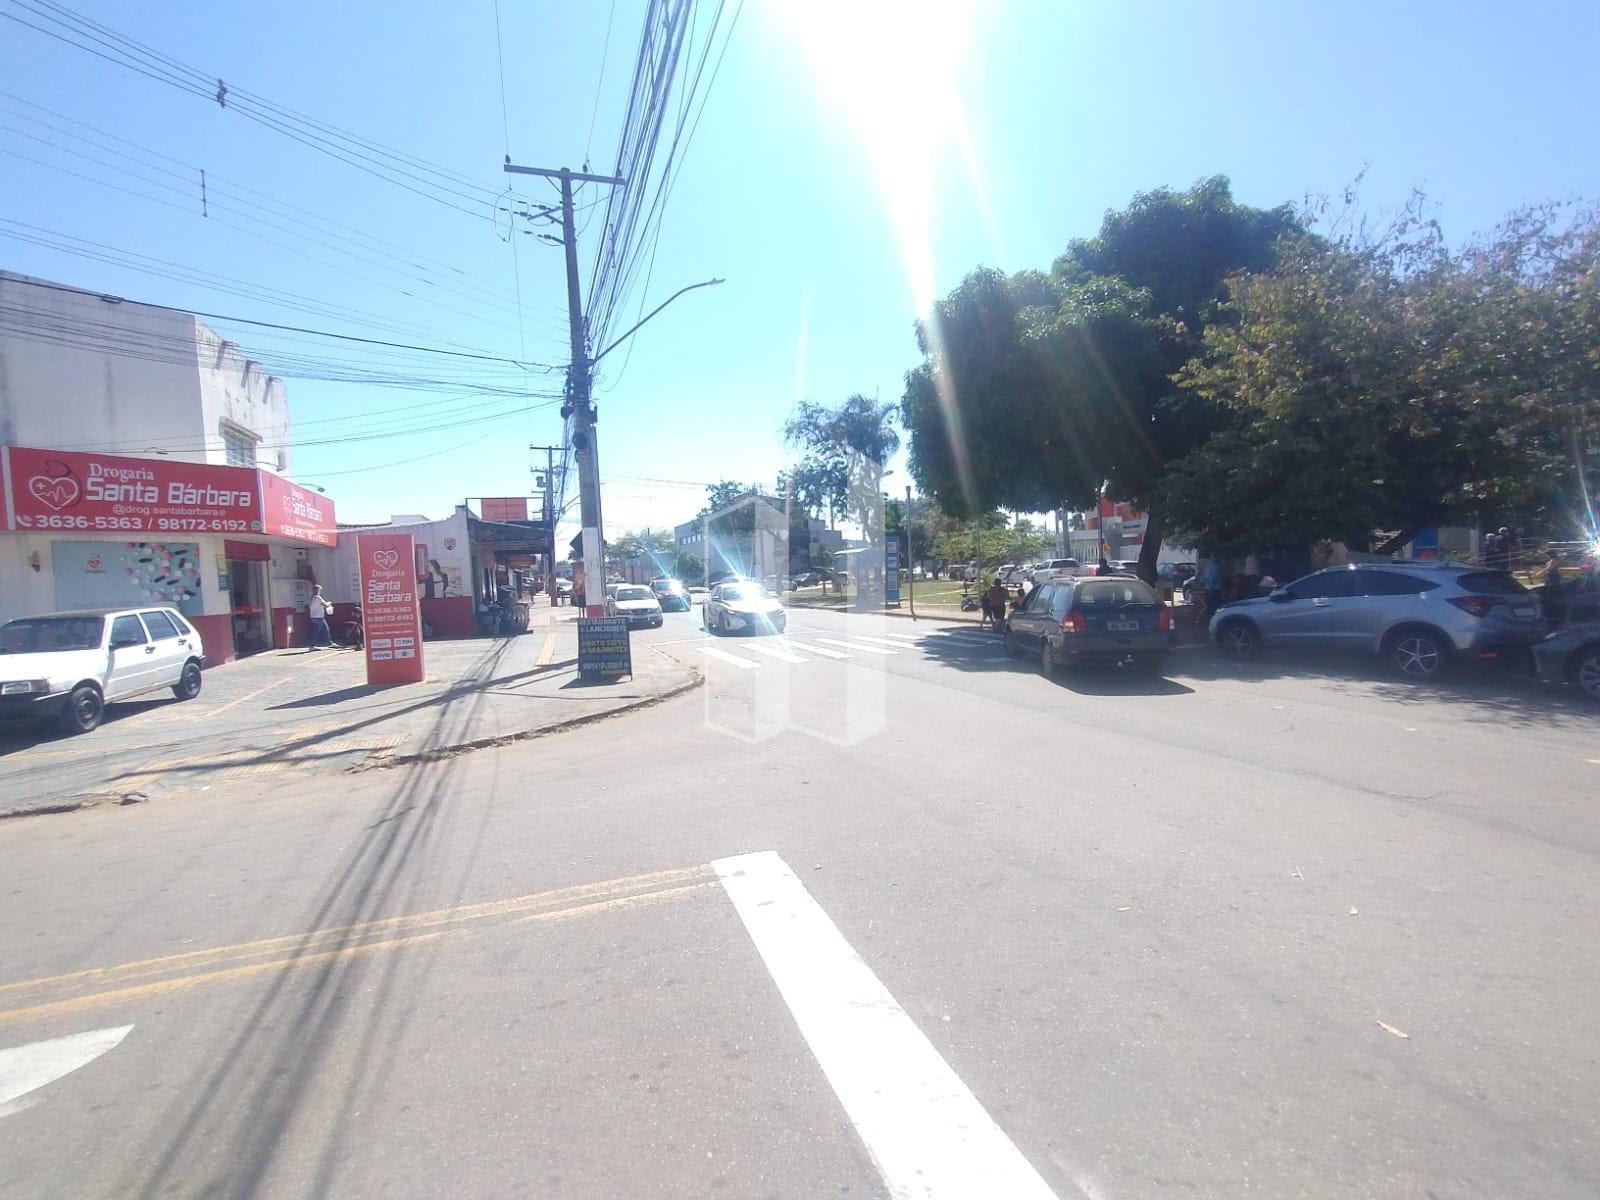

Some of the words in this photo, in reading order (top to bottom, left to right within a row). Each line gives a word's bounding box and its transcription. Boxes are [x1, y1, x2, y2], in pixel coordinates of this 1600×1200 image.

[89, 463, 155, 482] Drogaria
[85, 477, 159, 503] Santa
[167, 482, 252, 507] Bárbara
[36, 515, 142, 530] 3636-5363
[158, 518, 247, 531] 98172-6192
[372, 569, 405, 578] Drogaria
[368, 580, 400, 591] Santa
[368, 591, 412, 604] Bárbara
